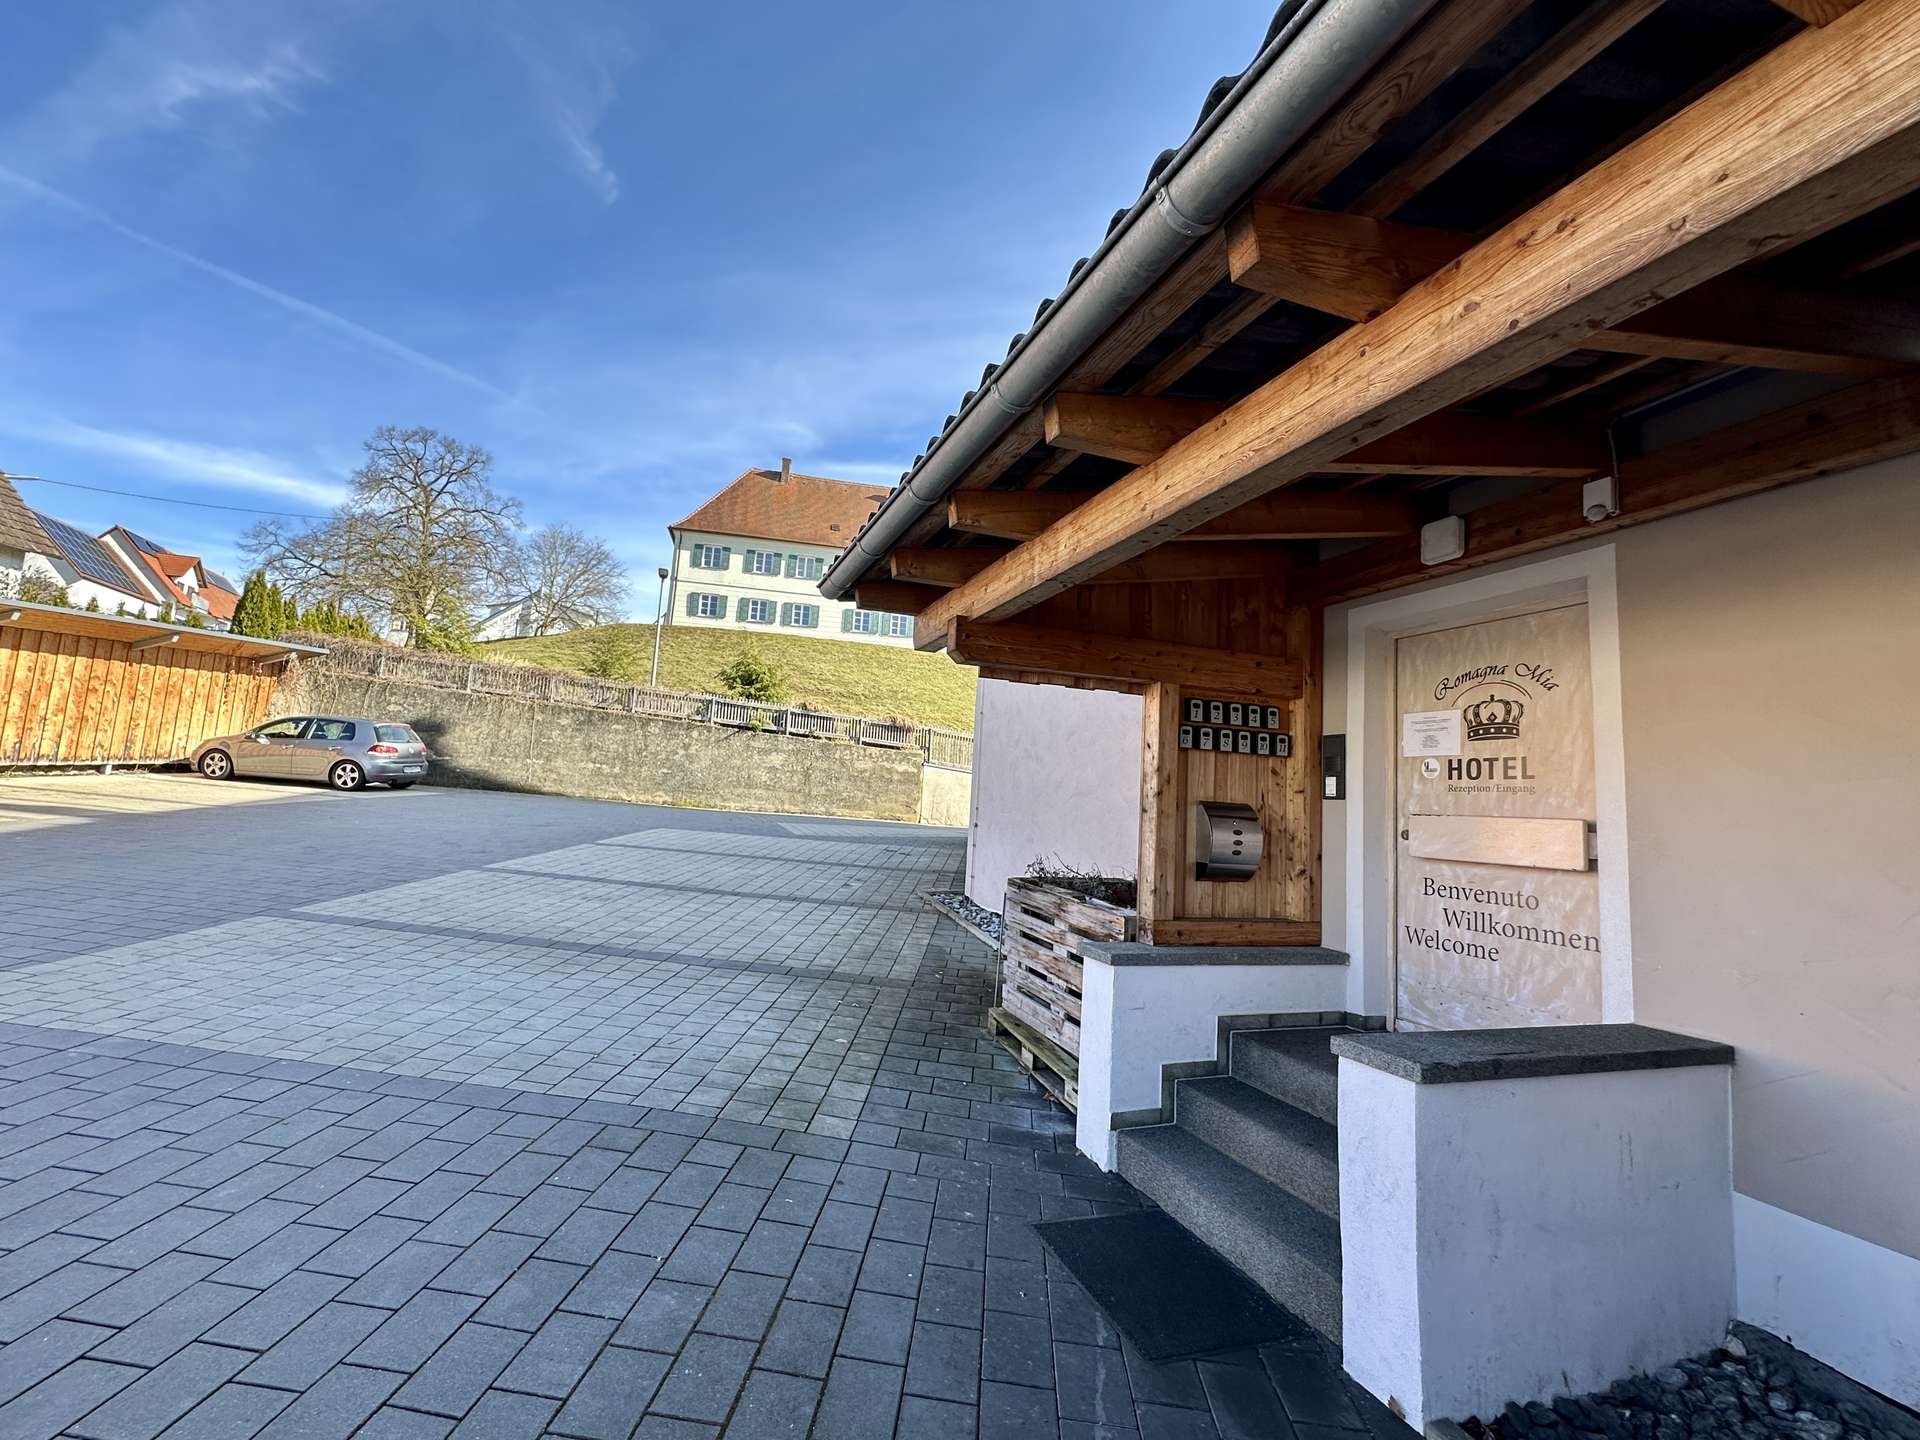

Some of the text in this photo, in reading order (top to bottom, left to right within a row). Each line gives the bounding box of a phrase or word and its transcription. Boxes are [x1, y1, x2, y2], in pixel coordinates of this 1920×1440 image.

[1434, 663, 1559, 700] Romagna Mia
[1448, 756, 1535, 780] HOTEL
[1423, 877, 1539, 911] Benvenuto
[1405, 925, 1499, 962] Welcome
[1442, 907, 1600, 953] Willkommen
